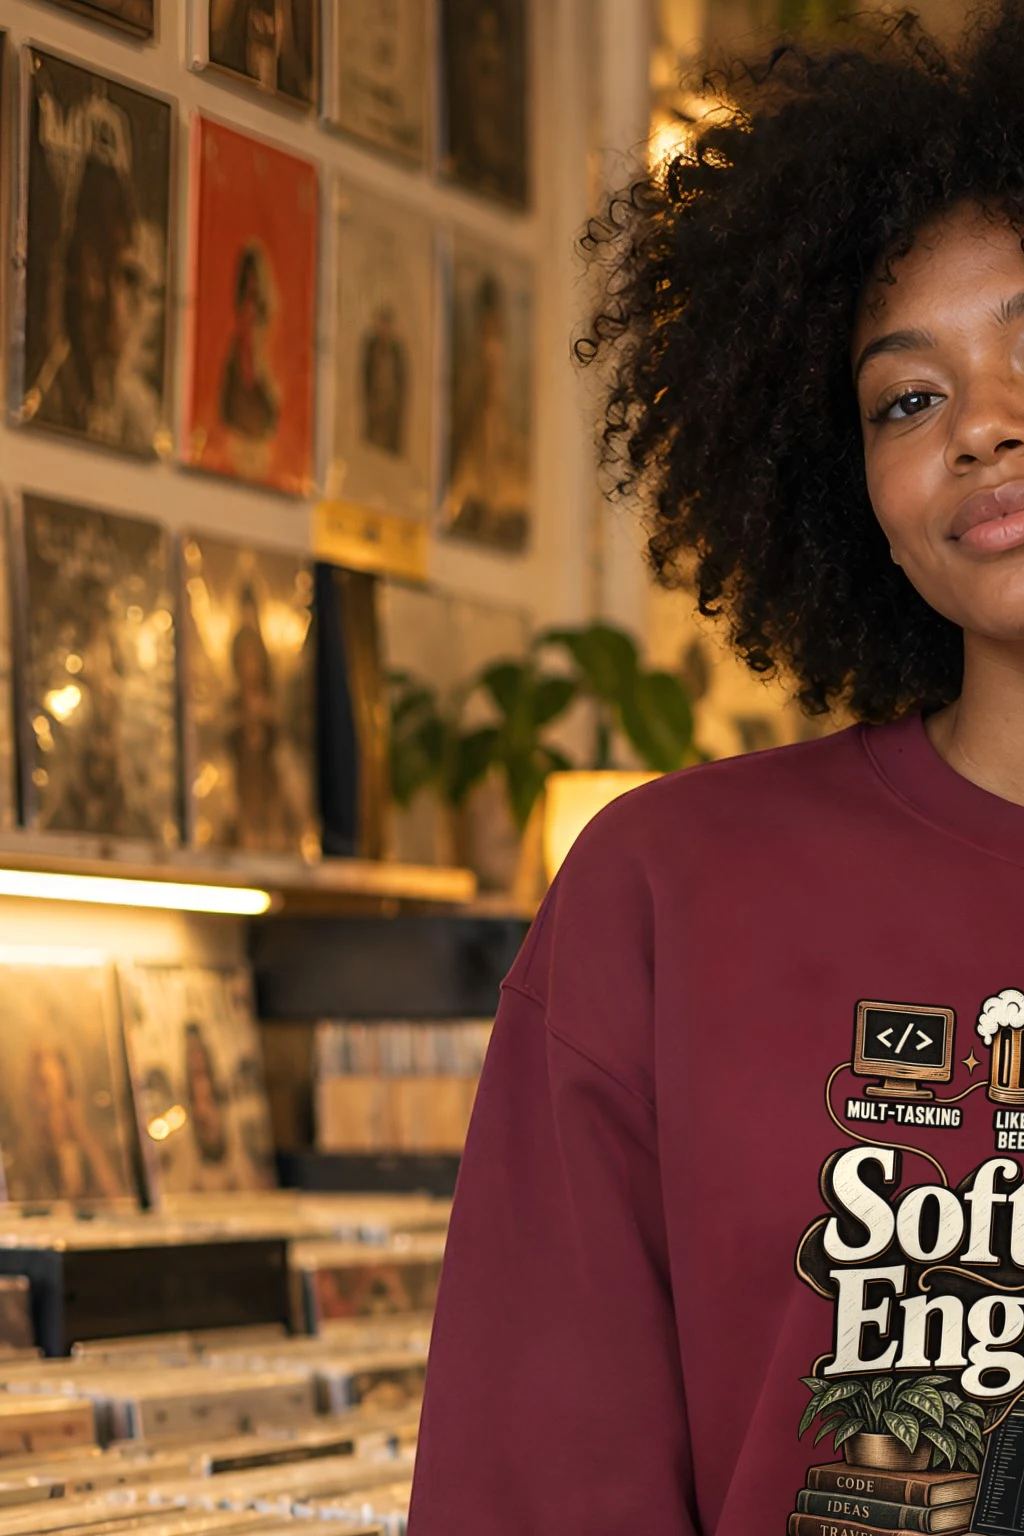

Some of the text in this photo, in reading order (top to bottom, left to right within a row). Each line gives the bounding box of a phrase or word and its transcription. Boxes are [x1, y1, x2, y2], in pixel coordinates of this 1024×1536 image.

[847, 1100, 960, 1126] MULT-TASKING
[836, 1476, 875, 1493] CODE
[827, 1500, 870, 1519] IDEAS
